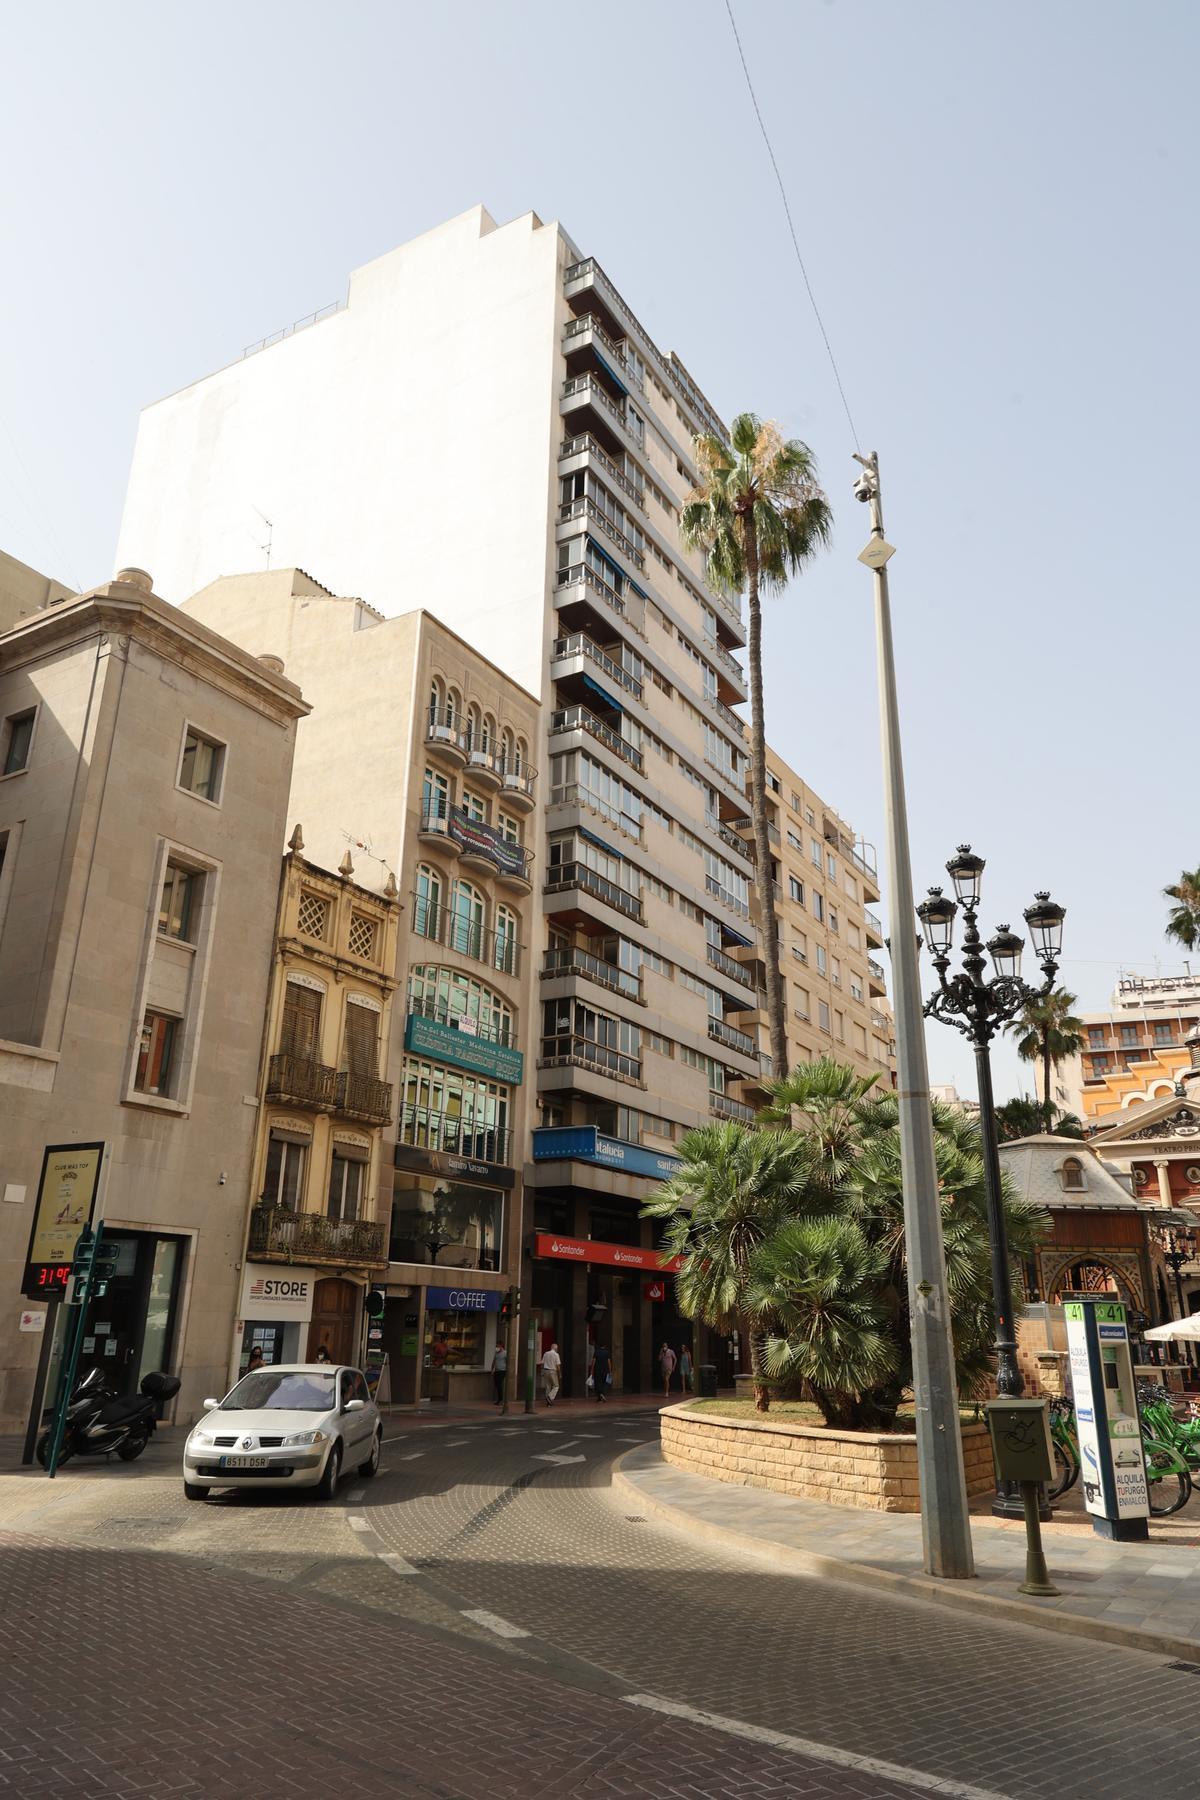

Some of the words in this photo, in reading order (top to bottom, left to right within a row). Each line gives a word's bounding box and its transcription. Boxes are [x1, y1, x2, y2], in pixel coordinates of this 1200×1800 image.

[1153, 1146, 1183, 1154] TEATRO
[558, 1243, 585, 1256] Santander
[620, 1252, 643, 1264] Santander
[264, 1280, 308, 1296] STORE
[449, 1291, 487, 1309] COFFEE
[1071, 1304, 1083, 1321] 41
[1107, 1305, 1124, 1322] 41
[1116, 1473, 1145, 1486] ALQUILA
